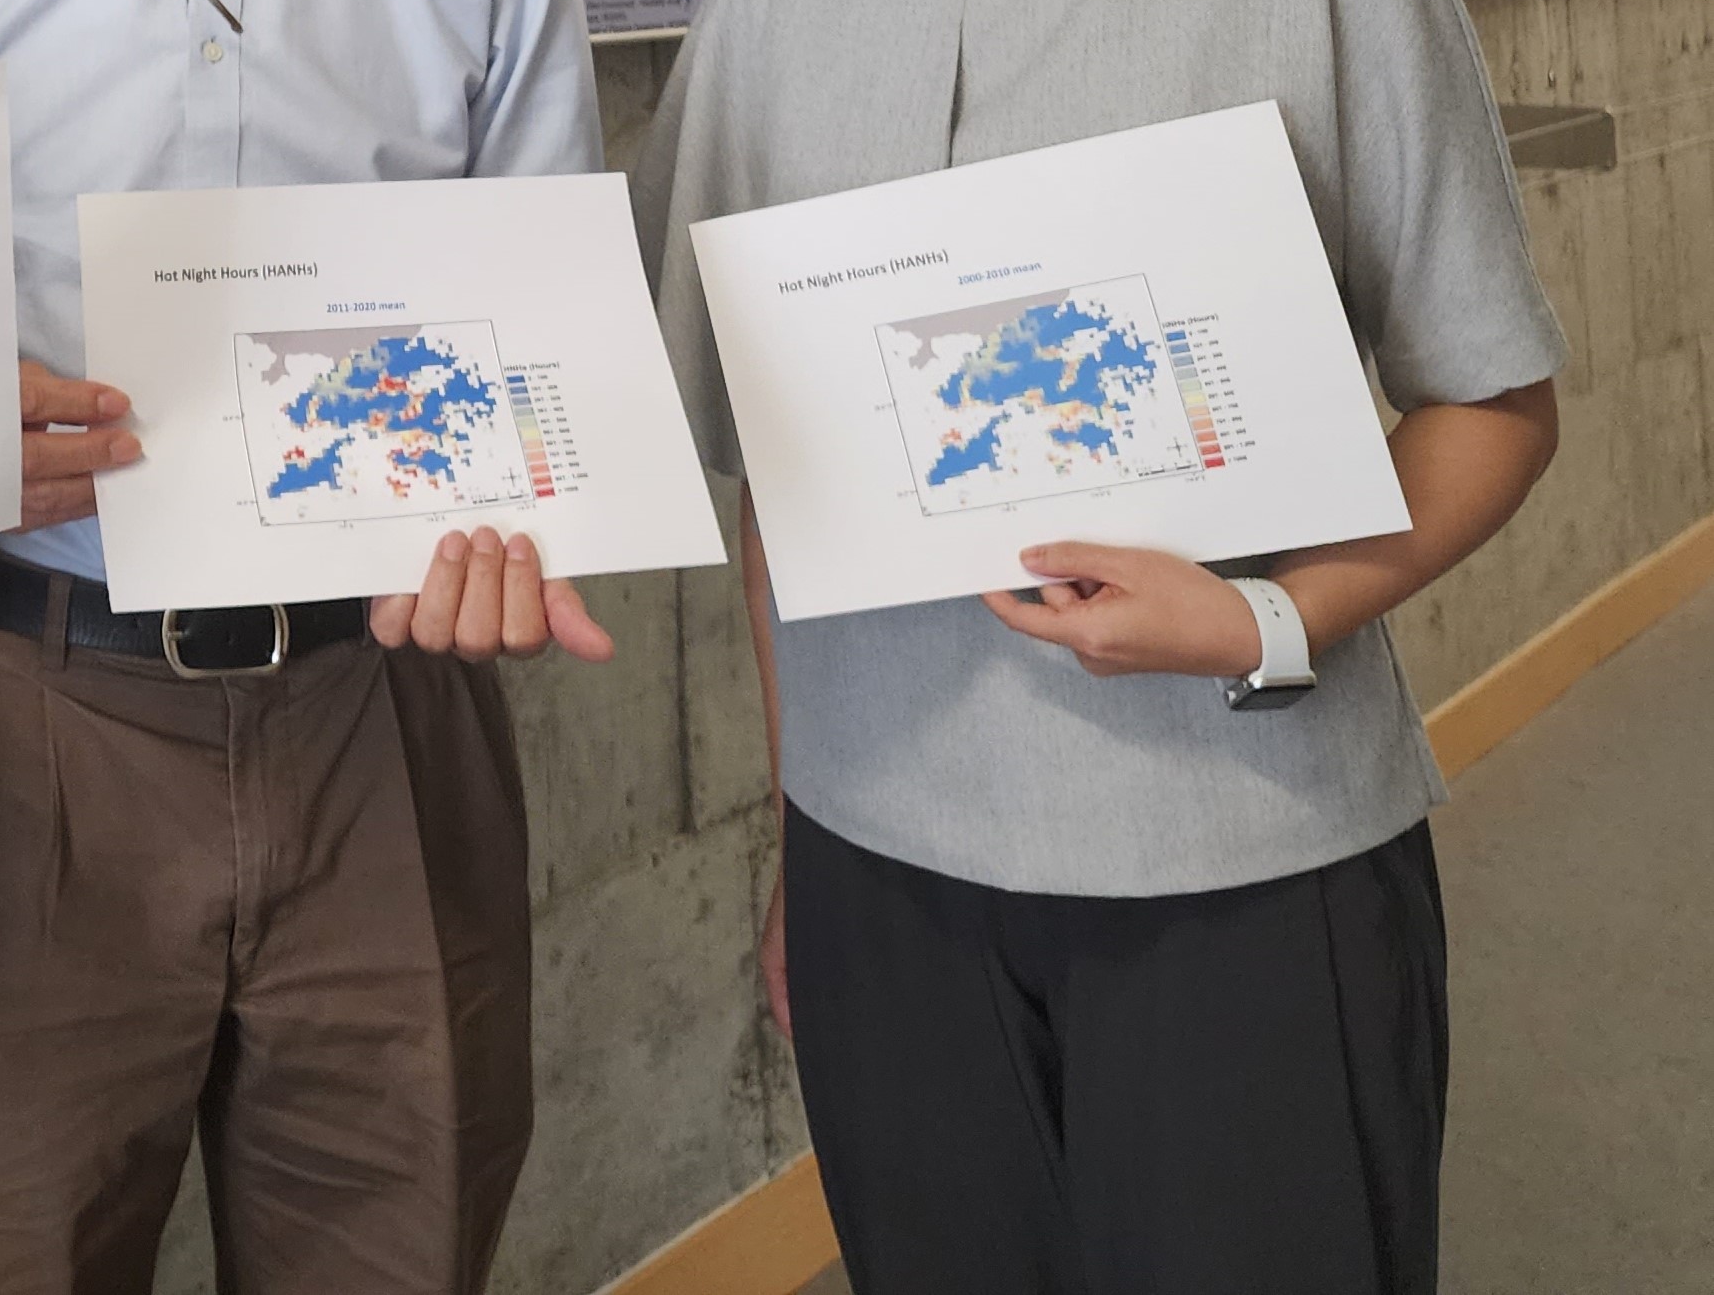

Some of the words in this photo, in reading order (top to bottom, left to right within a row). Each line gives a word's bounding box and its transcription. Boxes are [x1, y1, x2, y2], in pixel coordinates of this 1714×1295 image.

[154, 269, 177, 283] Hot
[182, 267, 216, 283] Night
[221, 266, 259, 279] Hours
[262, 262, 318, 280] (HANHs)
[778, 278, 804, 295] Hot
[807, 271, 844, 288] Night
[846, 264, 887, 282] Hours
[889, 249, 949, 276] (HANHs)
[1013, 262, 1043, 274] mean
[379, 302, 406, 311] mean
